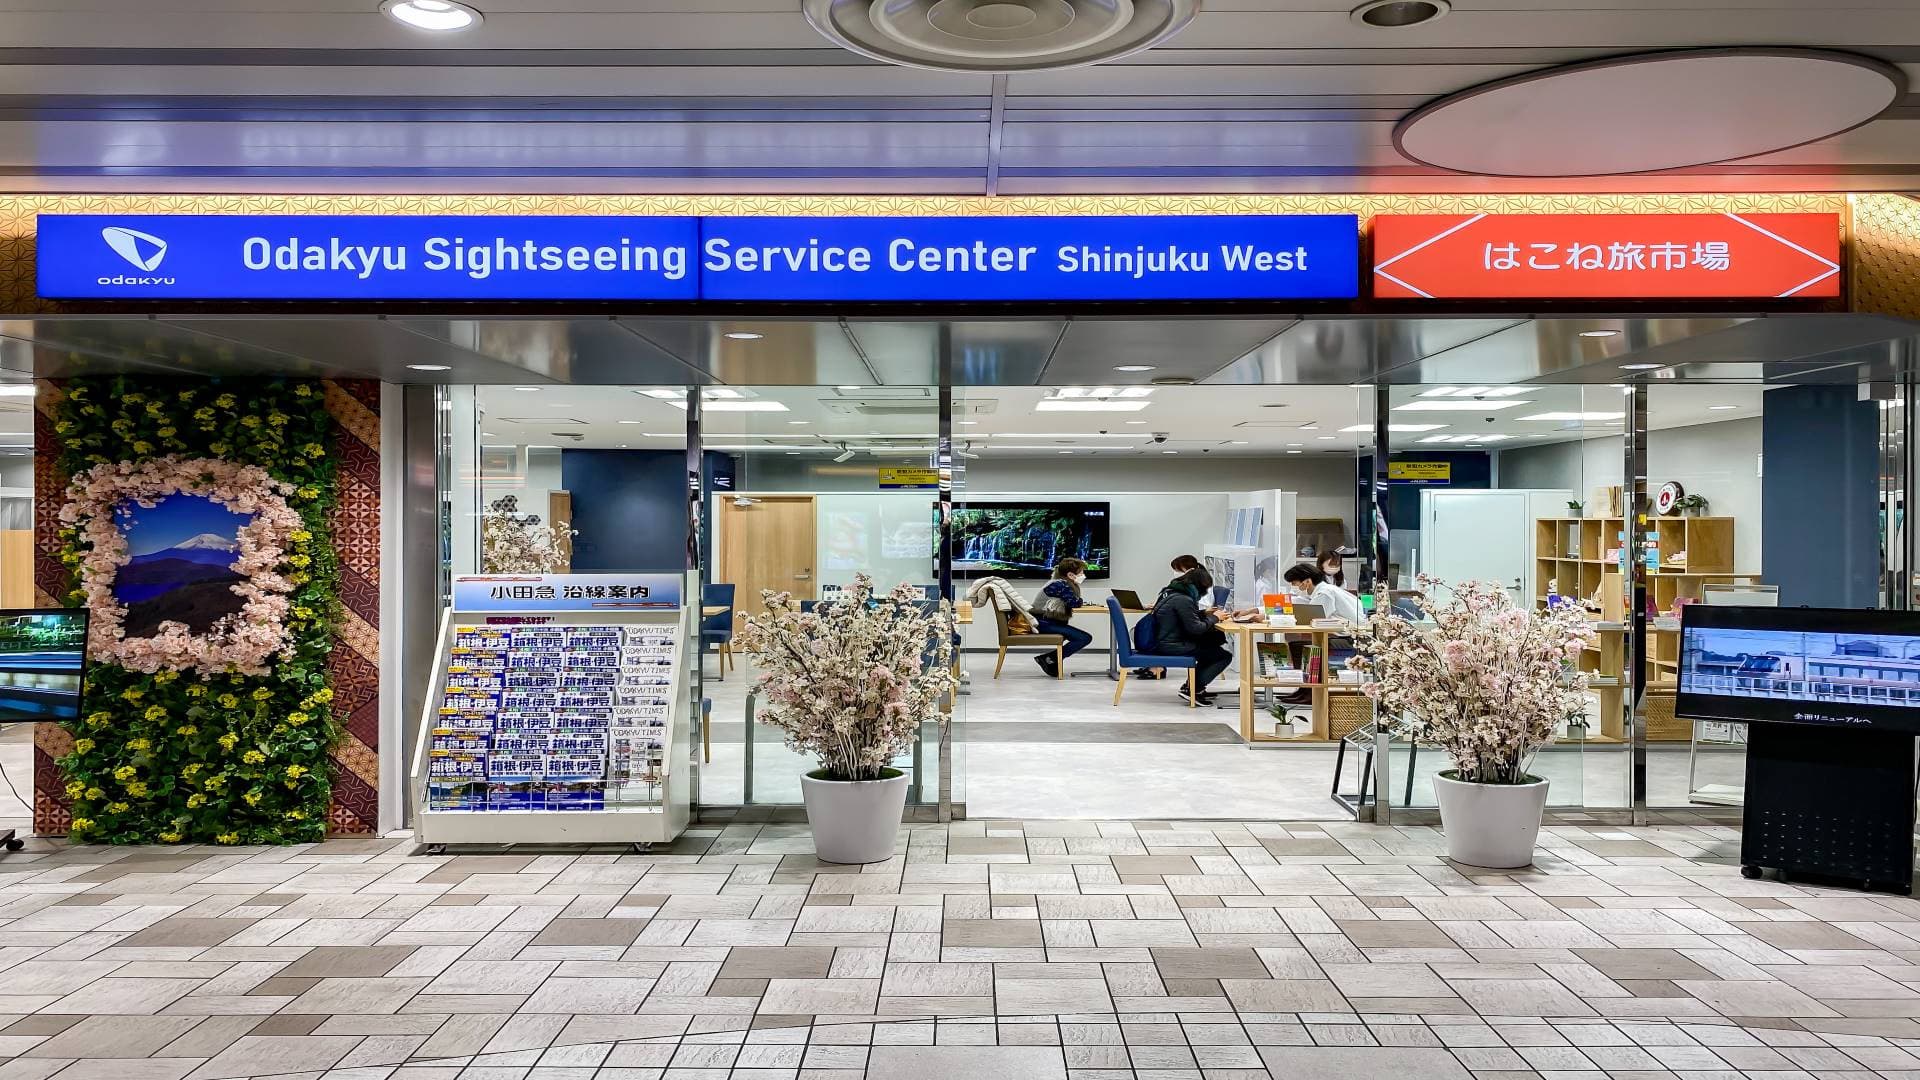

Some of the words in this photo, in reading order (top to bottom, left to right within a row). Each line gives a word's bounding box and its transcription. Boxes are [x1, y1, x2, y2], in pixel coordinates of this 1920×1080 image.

[243, 236, 406, 280] Odakyu
[423, 237, 686, 280] Sightseeing
[704, 238, 871, 272] Service
[888, 238, 1037, 272] Center
[1057, 245, 1209, 279] Shinjuku
[1220, 245, 1308, 271] West
[1484, 241, 1730, 271] はこね旅市場
[490, 585, 556, 599] 小田急
[563, 585, 649, 599] 沿線案内
